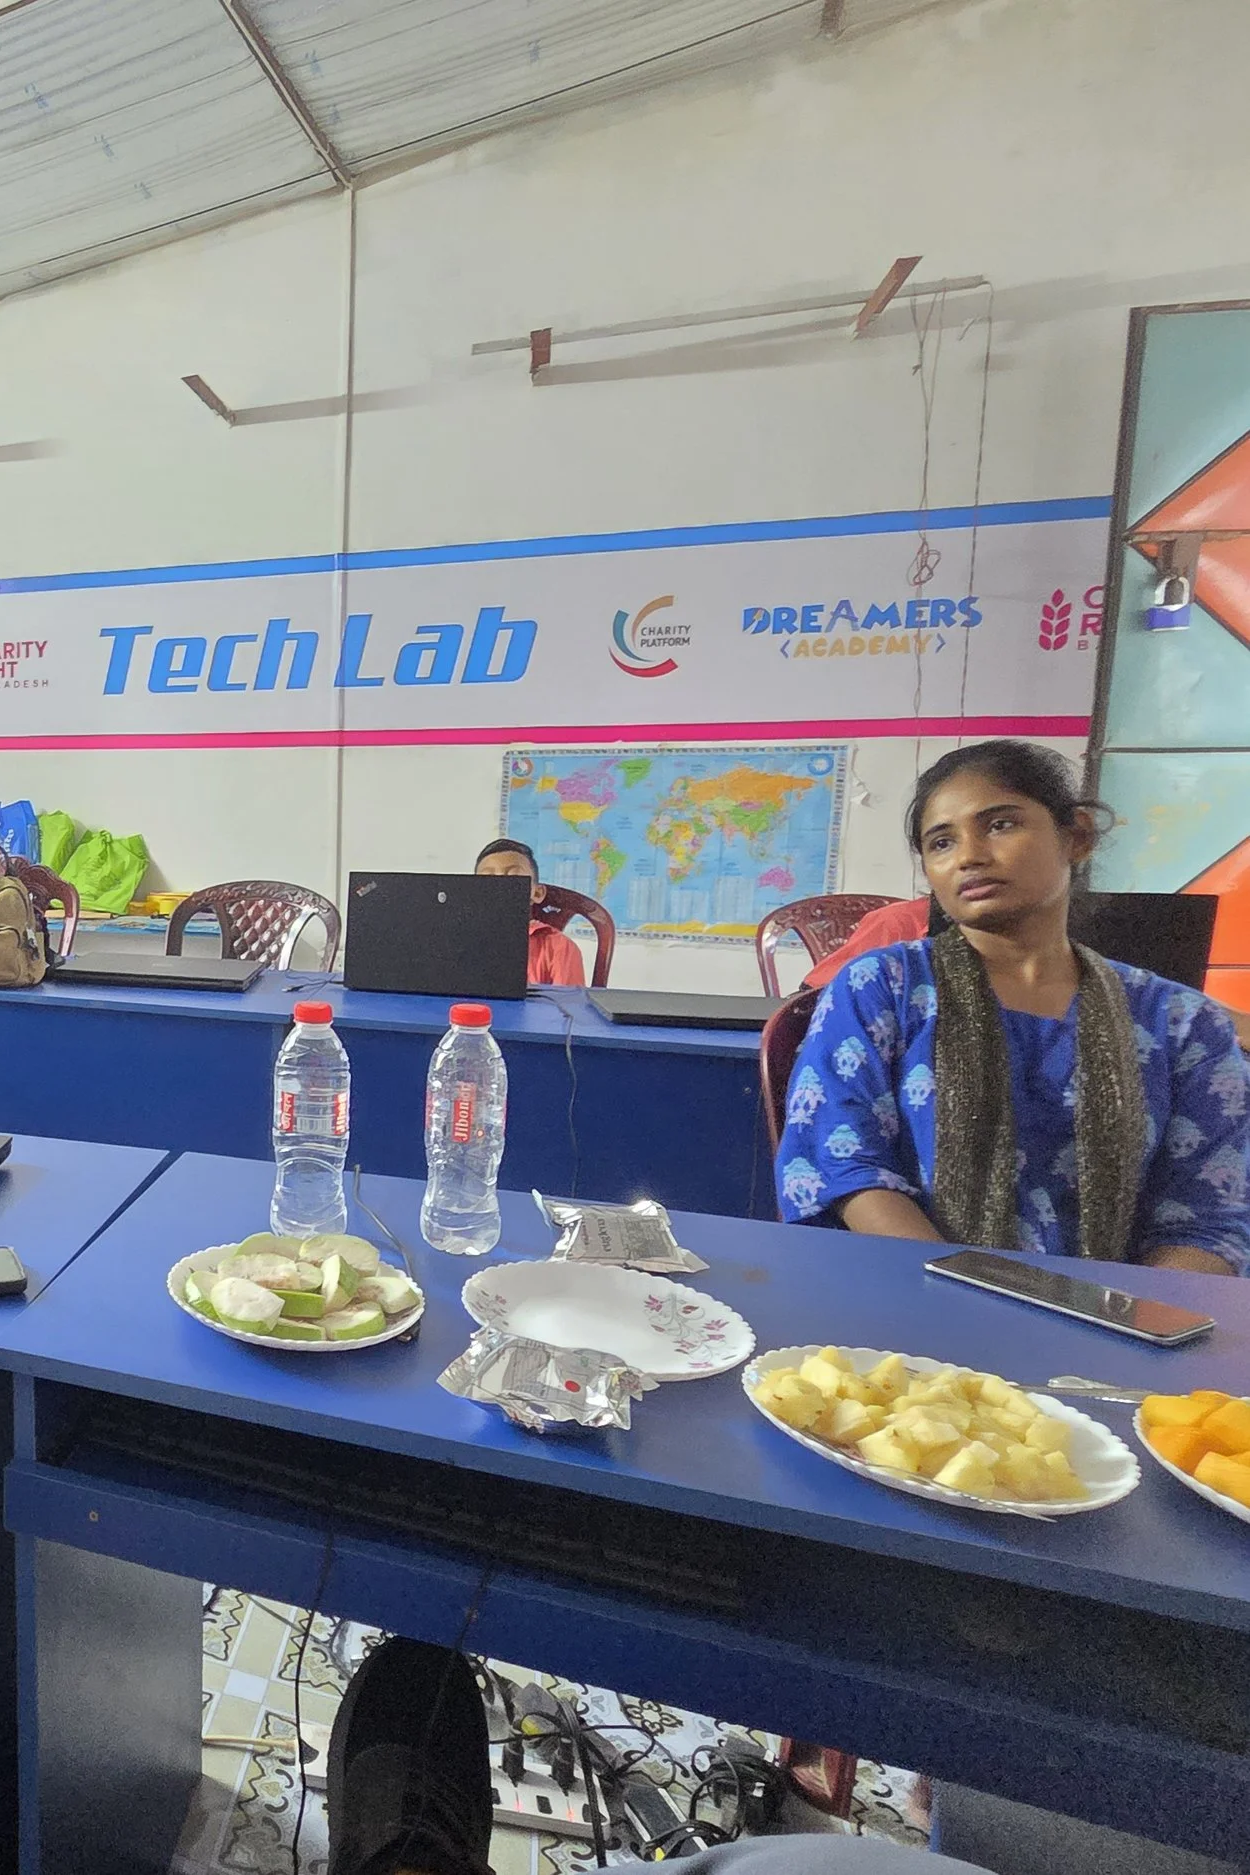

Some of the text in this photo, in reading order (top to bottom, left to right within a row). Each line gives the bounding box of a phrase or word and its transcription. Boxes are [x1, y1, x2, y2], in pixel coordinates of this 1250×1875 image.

[639, 624, 692, 637] CHARITY
[741, 596, 984, 635] DREAMERS
[99, 606, 539, 696] Tech Lab
[639, 636, 691, 649] PLATFORM
[453, 1102, 470, 1142] Jibon
